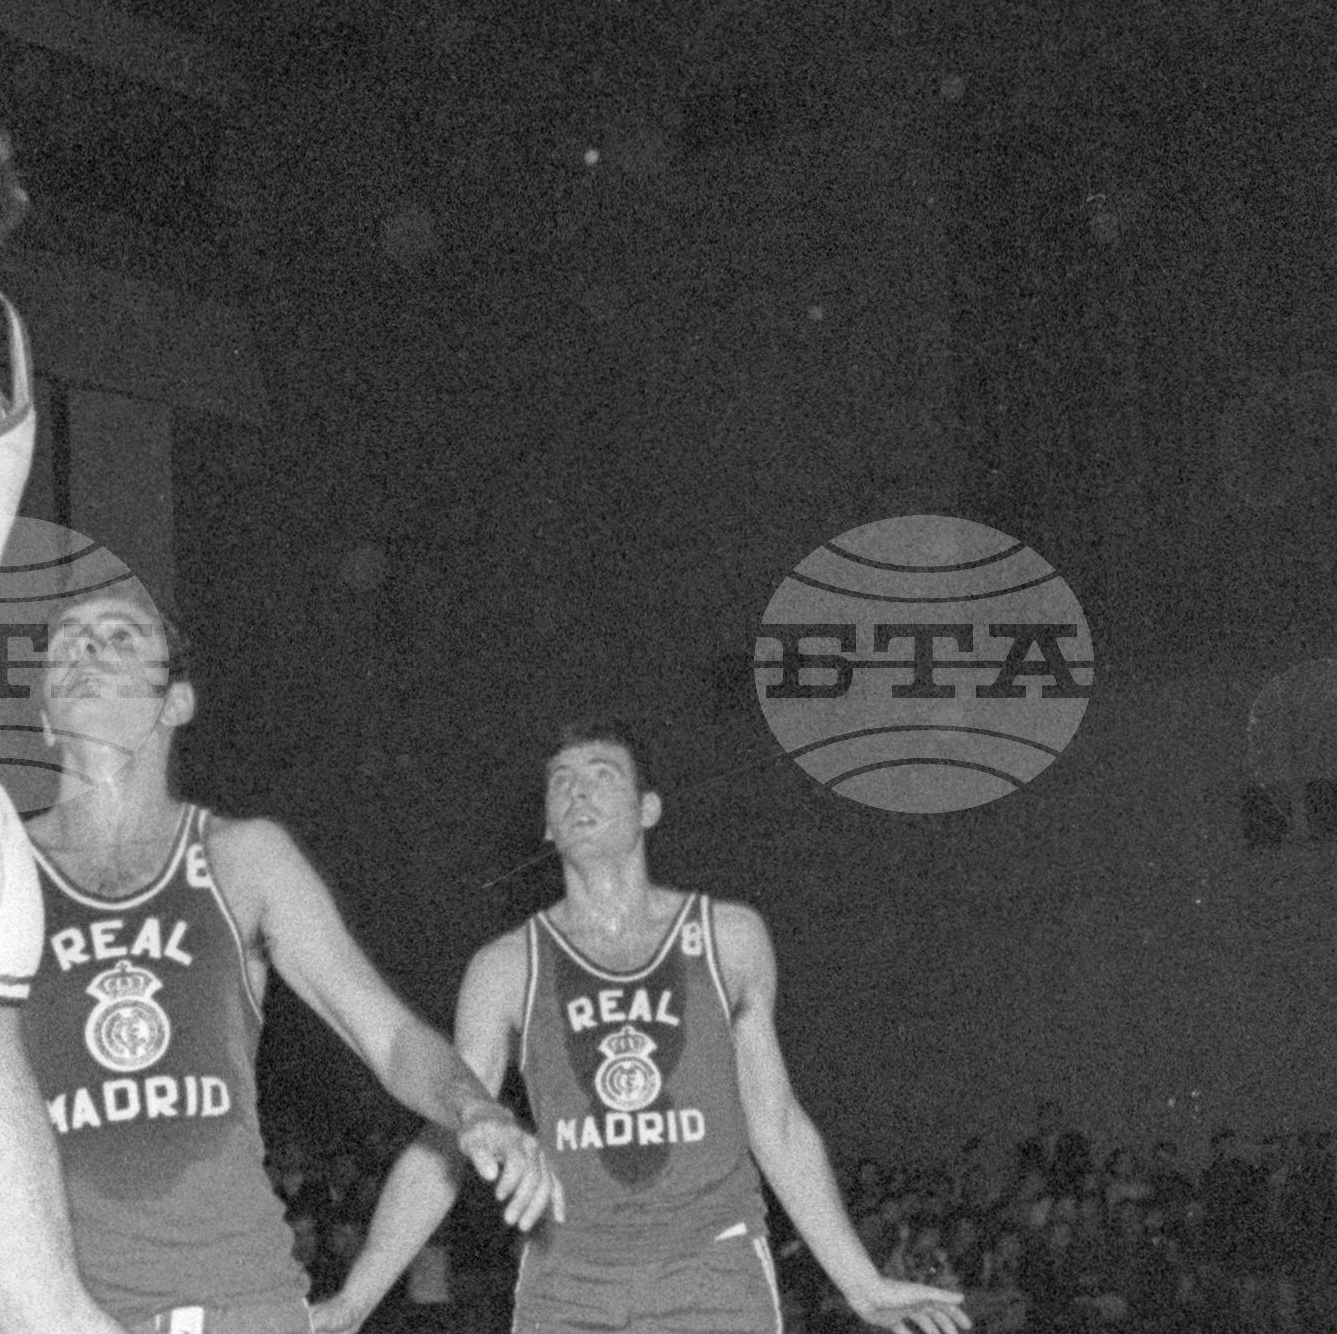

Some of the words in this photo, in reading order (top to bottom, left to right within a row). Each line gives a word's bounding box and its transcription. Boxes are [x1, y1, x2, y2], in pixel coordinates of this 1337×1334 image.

[50, 917, 193, 972] REAL
[681, 921, 702, 956] 8
[567, 988, 680, 1033] REAL
[556, 1108, 706, 1152] MADRID
